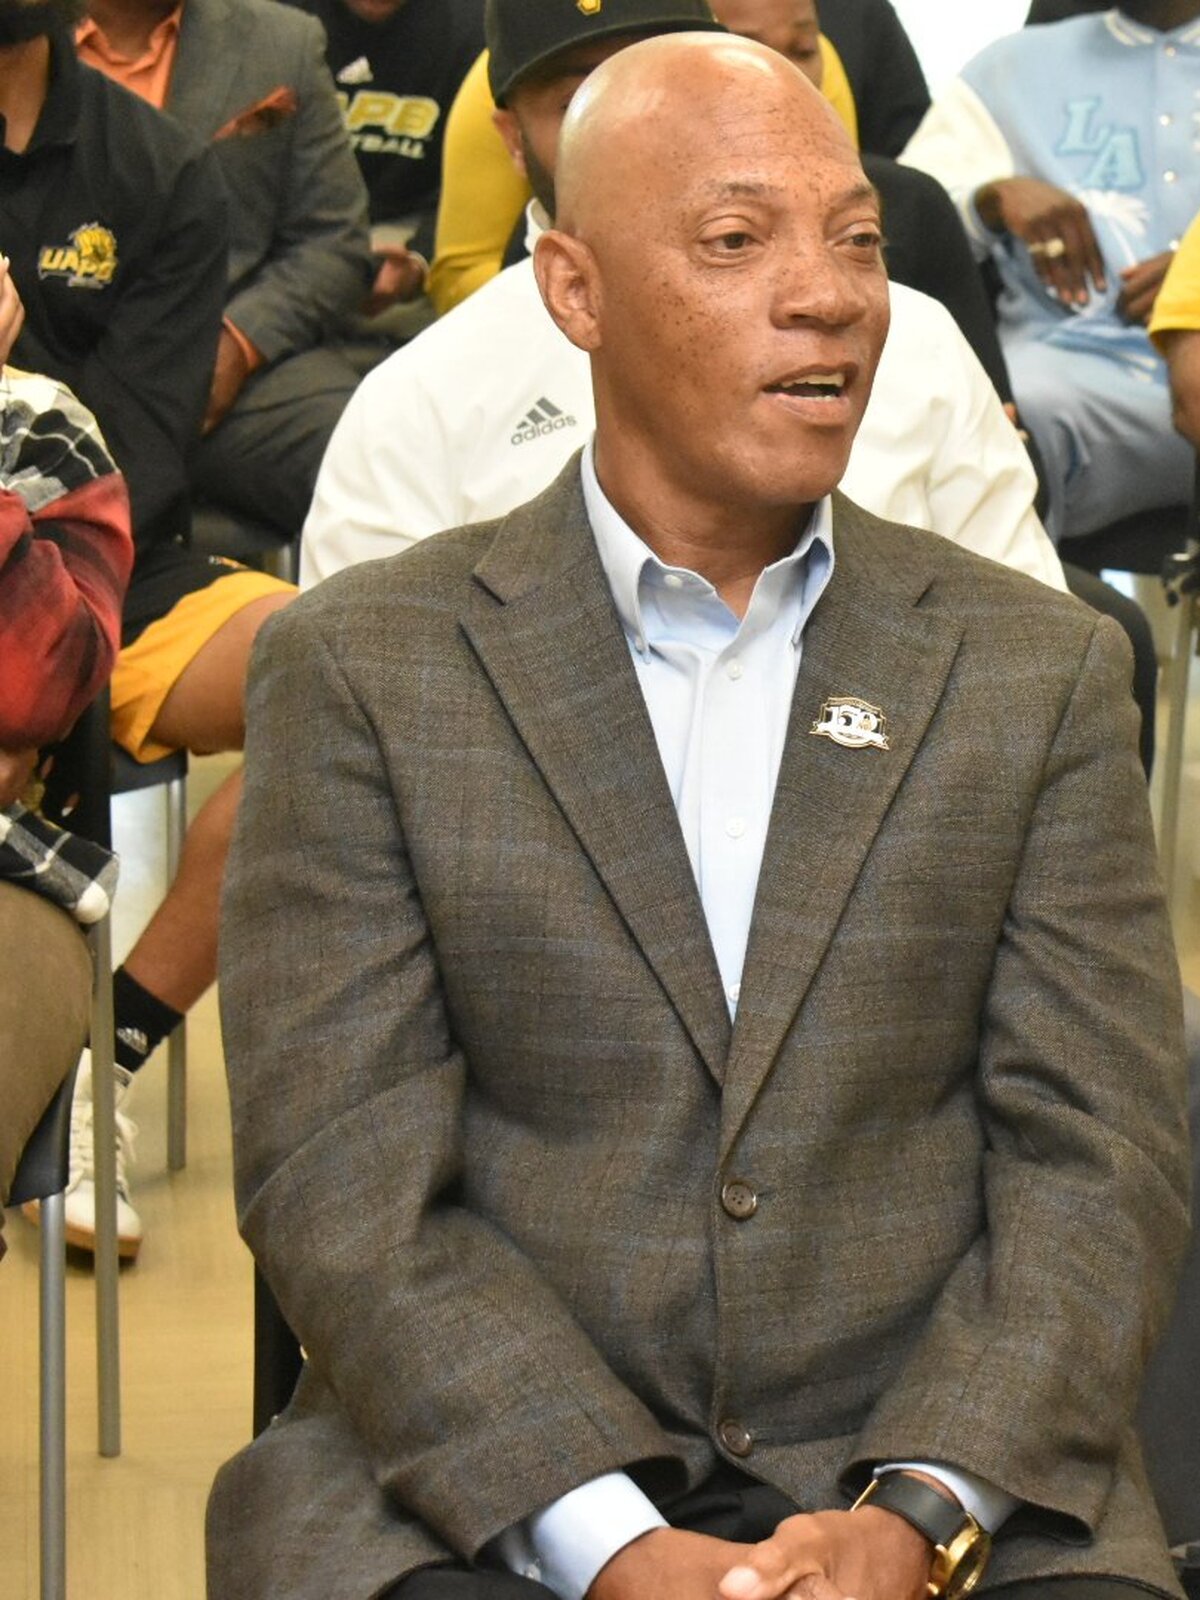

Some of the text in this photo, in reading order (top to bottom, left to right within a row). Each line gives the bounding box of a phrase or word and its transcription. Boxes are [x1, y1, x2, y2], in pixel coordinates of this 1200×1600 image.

[336, 89, 440, 140] PB
[1056, 97, 1145, 190] LA
[511, 415, 577, 445] adidas
